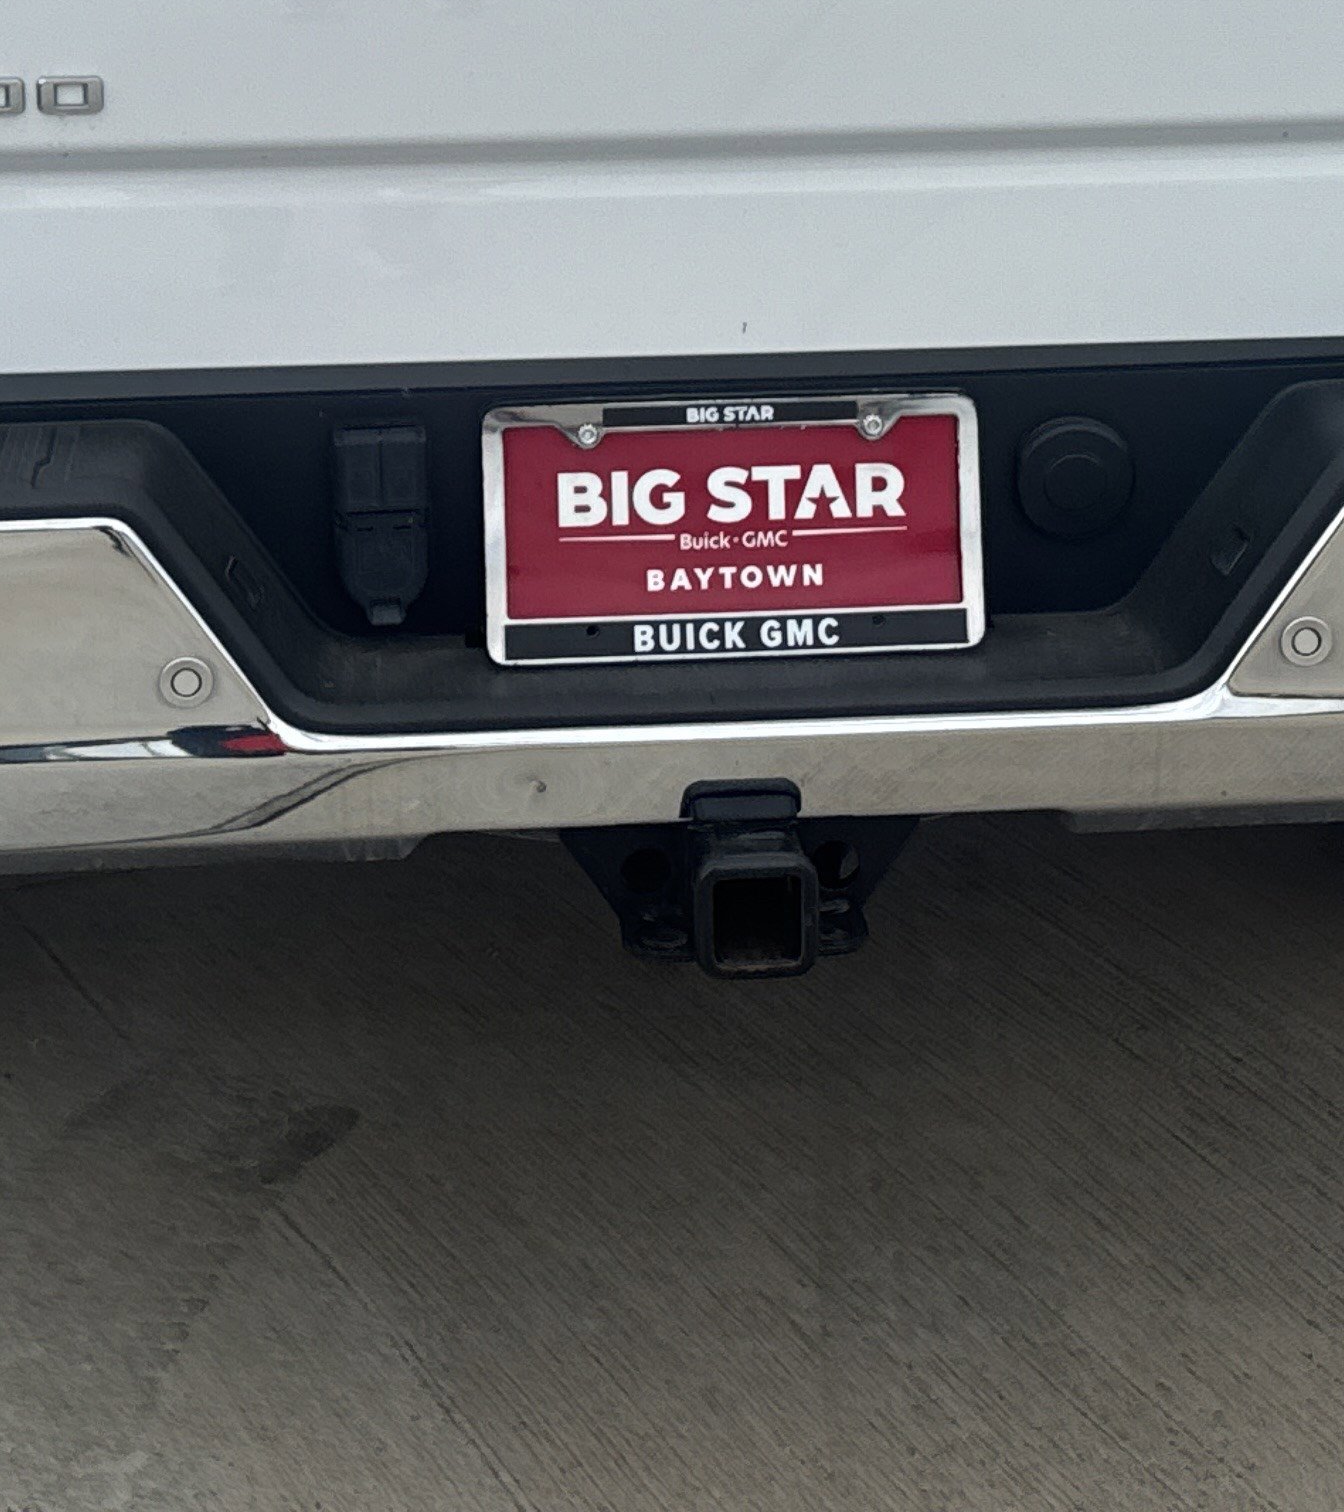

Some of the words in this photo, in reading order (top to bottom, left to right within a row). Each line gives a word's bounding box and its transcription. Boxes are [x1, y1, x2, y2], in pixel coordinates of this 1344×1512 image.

[686, 407, 720, 423] BIG
[723, 405, 774, 421] STAR
[557, 467, 685, 528] BIG
[707, 462, 907, 523] STAR
[646, 563, 824, 592] BAYTOWN
[633, 623, 745, 653] BUICK
[760, 617, 840, 646] GMC
